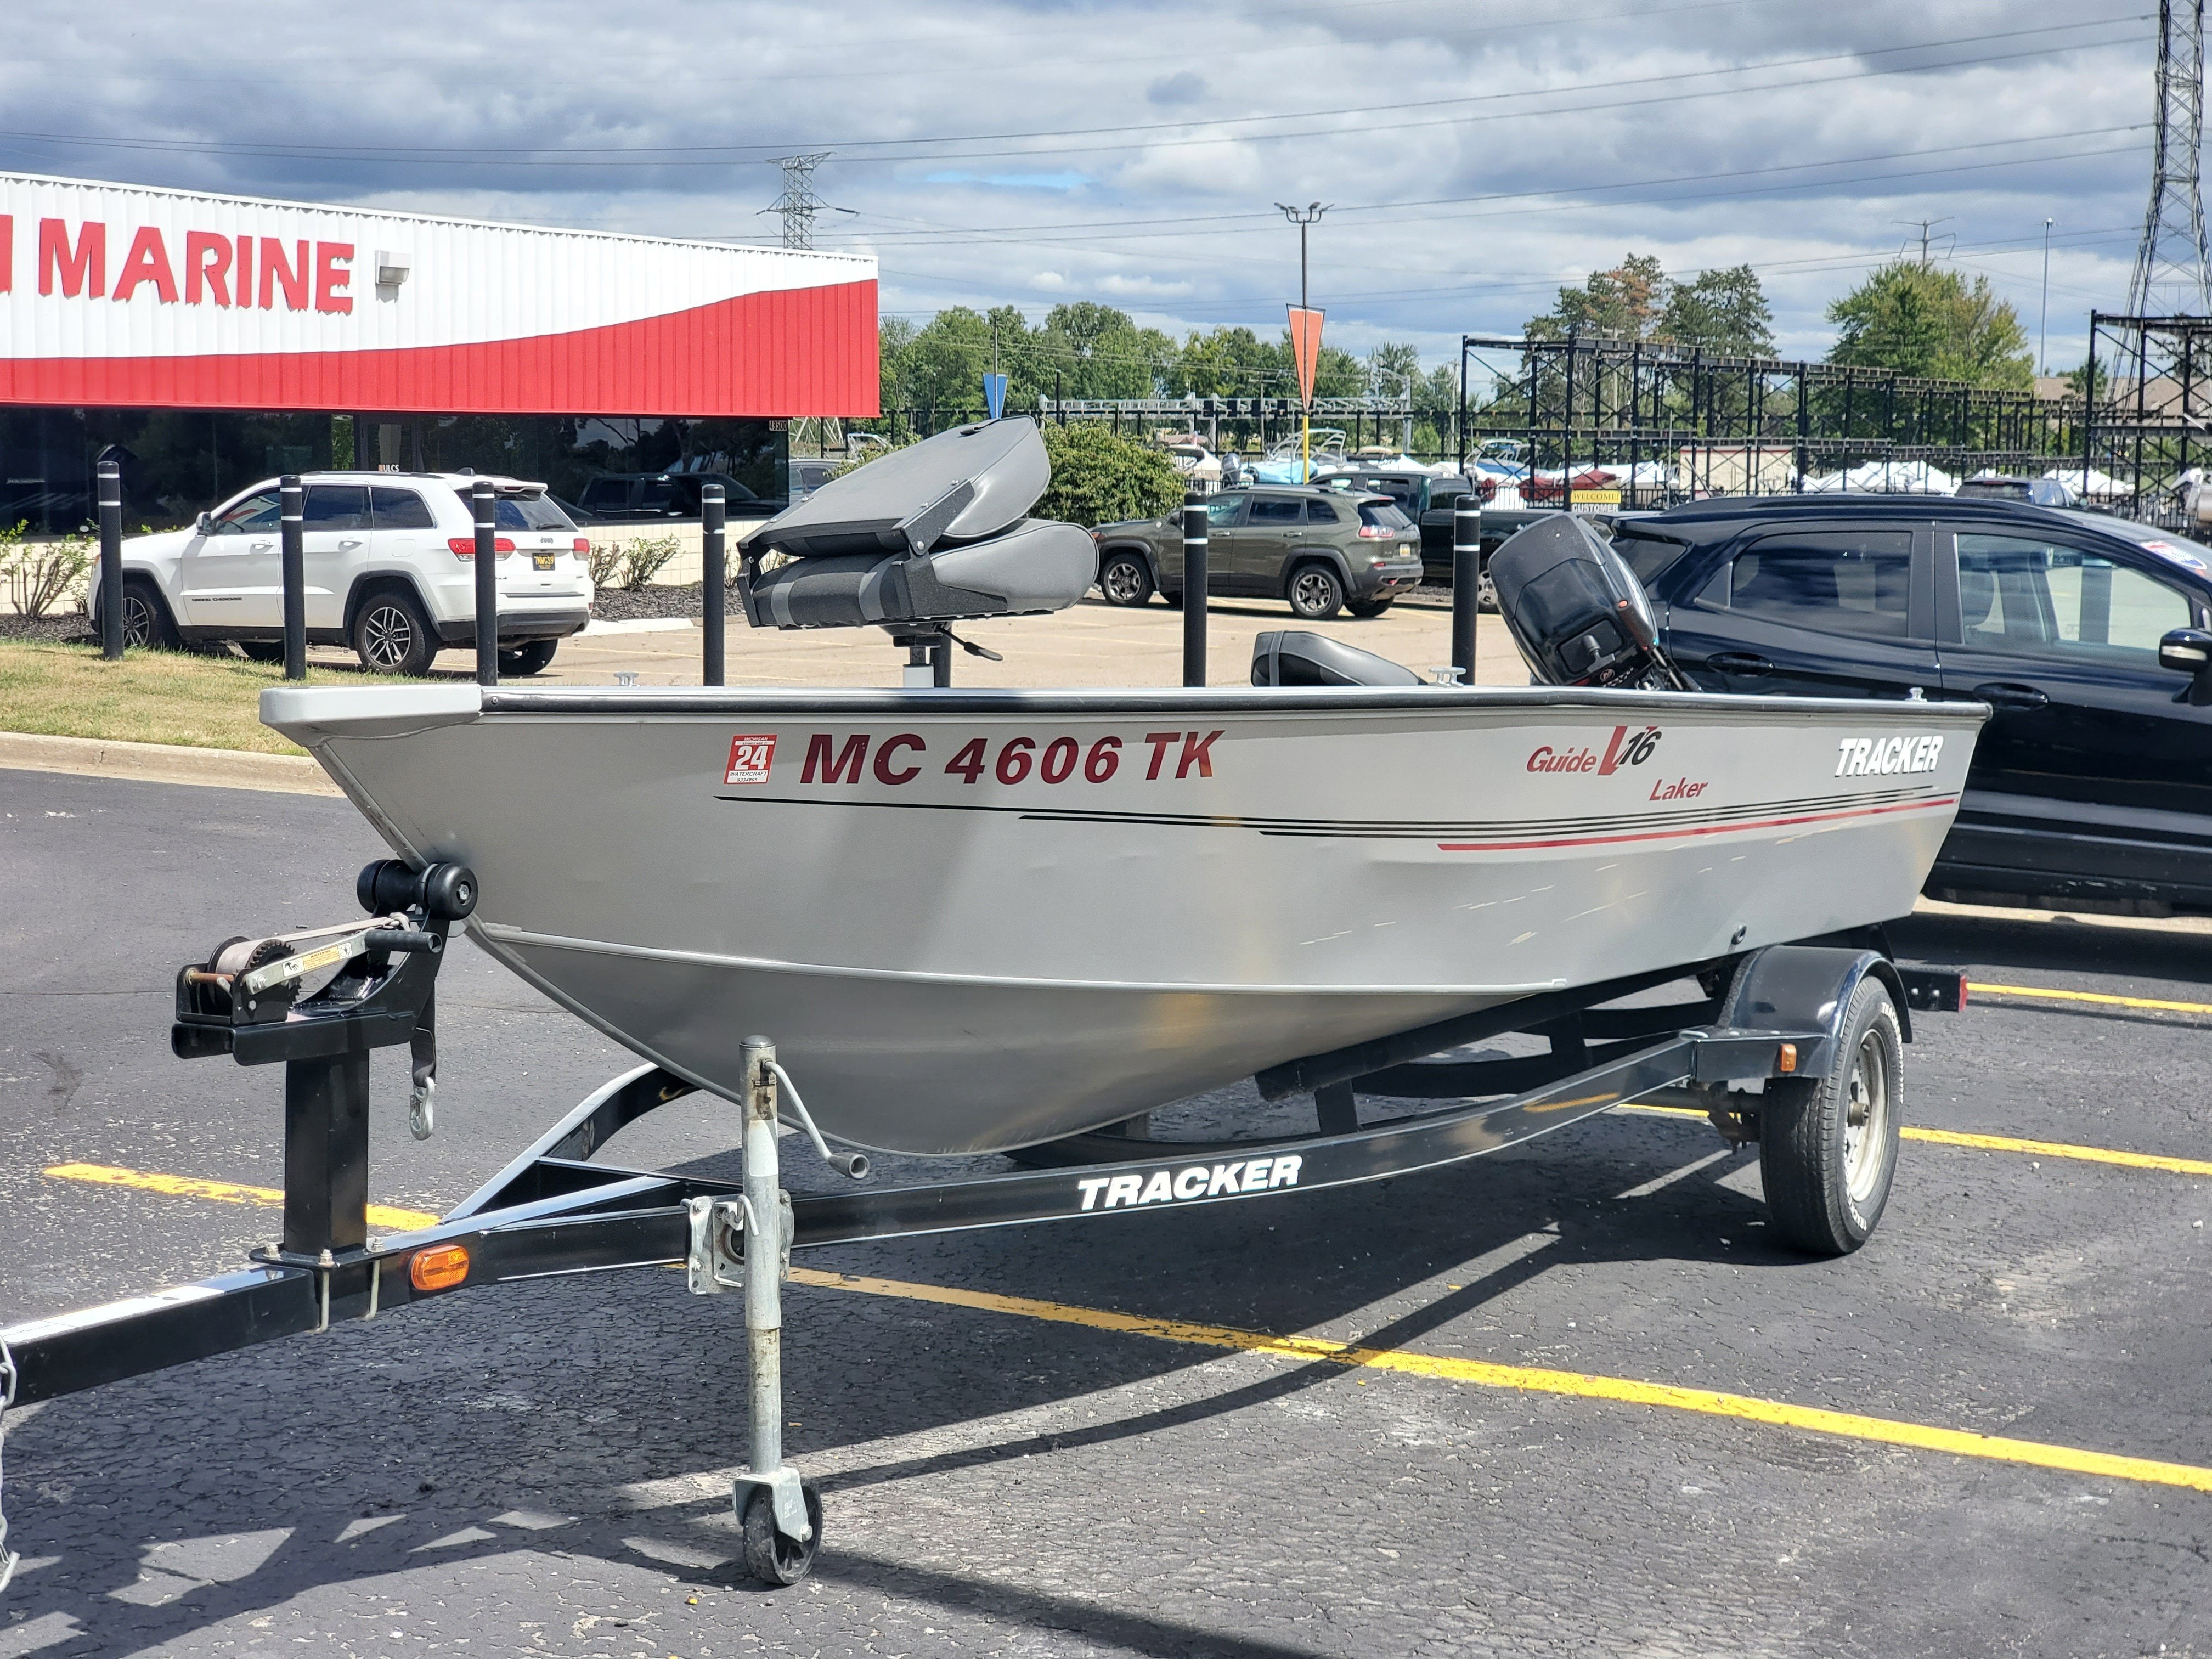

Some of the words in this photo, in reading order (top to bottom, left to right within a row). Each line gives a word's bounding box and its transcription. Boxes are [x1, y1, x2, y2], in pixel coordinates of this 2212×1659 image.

[38, 218, 354, 312] MARINE
[770, 421, 787, 431] 48500
[1572, 504, 1619, 513] CUSTOMER
[735, 746, 769, 770] 24
[799, 733, 927, 785] MC
[944, 736, 1123, 785] 4606
[1144, 730, 1226, 781] TK
[1527, 746, 1598, 773] Guide
[1835, 736, 1944, 778] TRACKER
[1649, 777, 1709, 801] Laker
[1078, 1155, 1304, 1211] TRACKER
